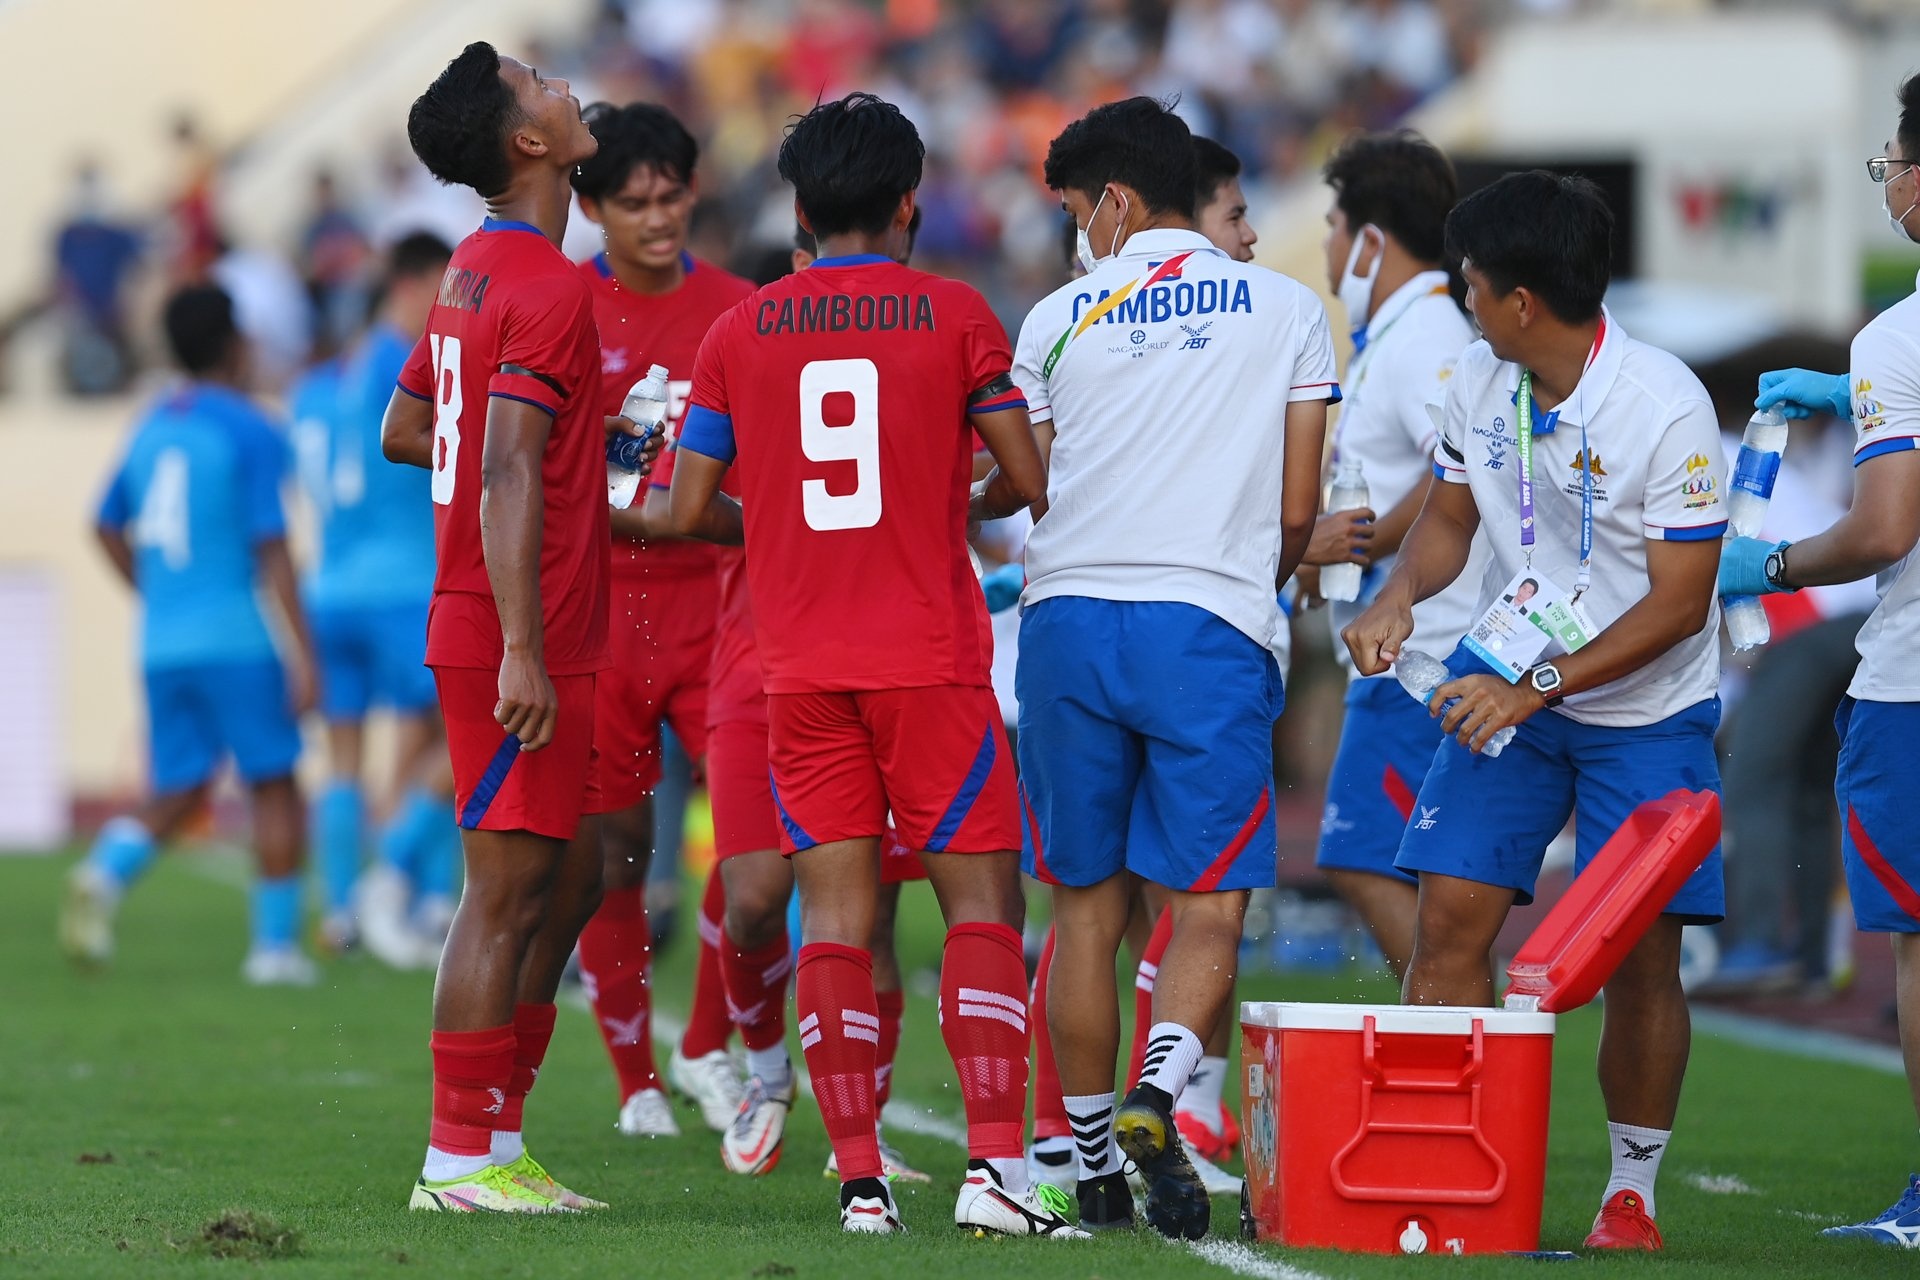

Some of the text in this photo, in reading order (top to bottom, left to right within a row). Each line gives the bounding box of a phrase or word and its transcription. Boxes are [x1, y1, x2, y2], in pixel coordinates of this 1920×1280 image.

[756, 294, 936, 336] CAMBODIA
[1072, 279, 1252, 326] CAMBODIA
[1178, 337, 1212, 351] FBT
[1520, 380, 1529, 429] STRONGER
[799, 358, 882, 532] 9
[1521, 429, 1531, 482] SOUTHEAST
[1484, 459, 1505, 470] FBT
[1522, 484, 1531, 507] ASIA
[1414, 819, 1437, 830] FBT
[1622, 1152, 1654, 1162] FBT
